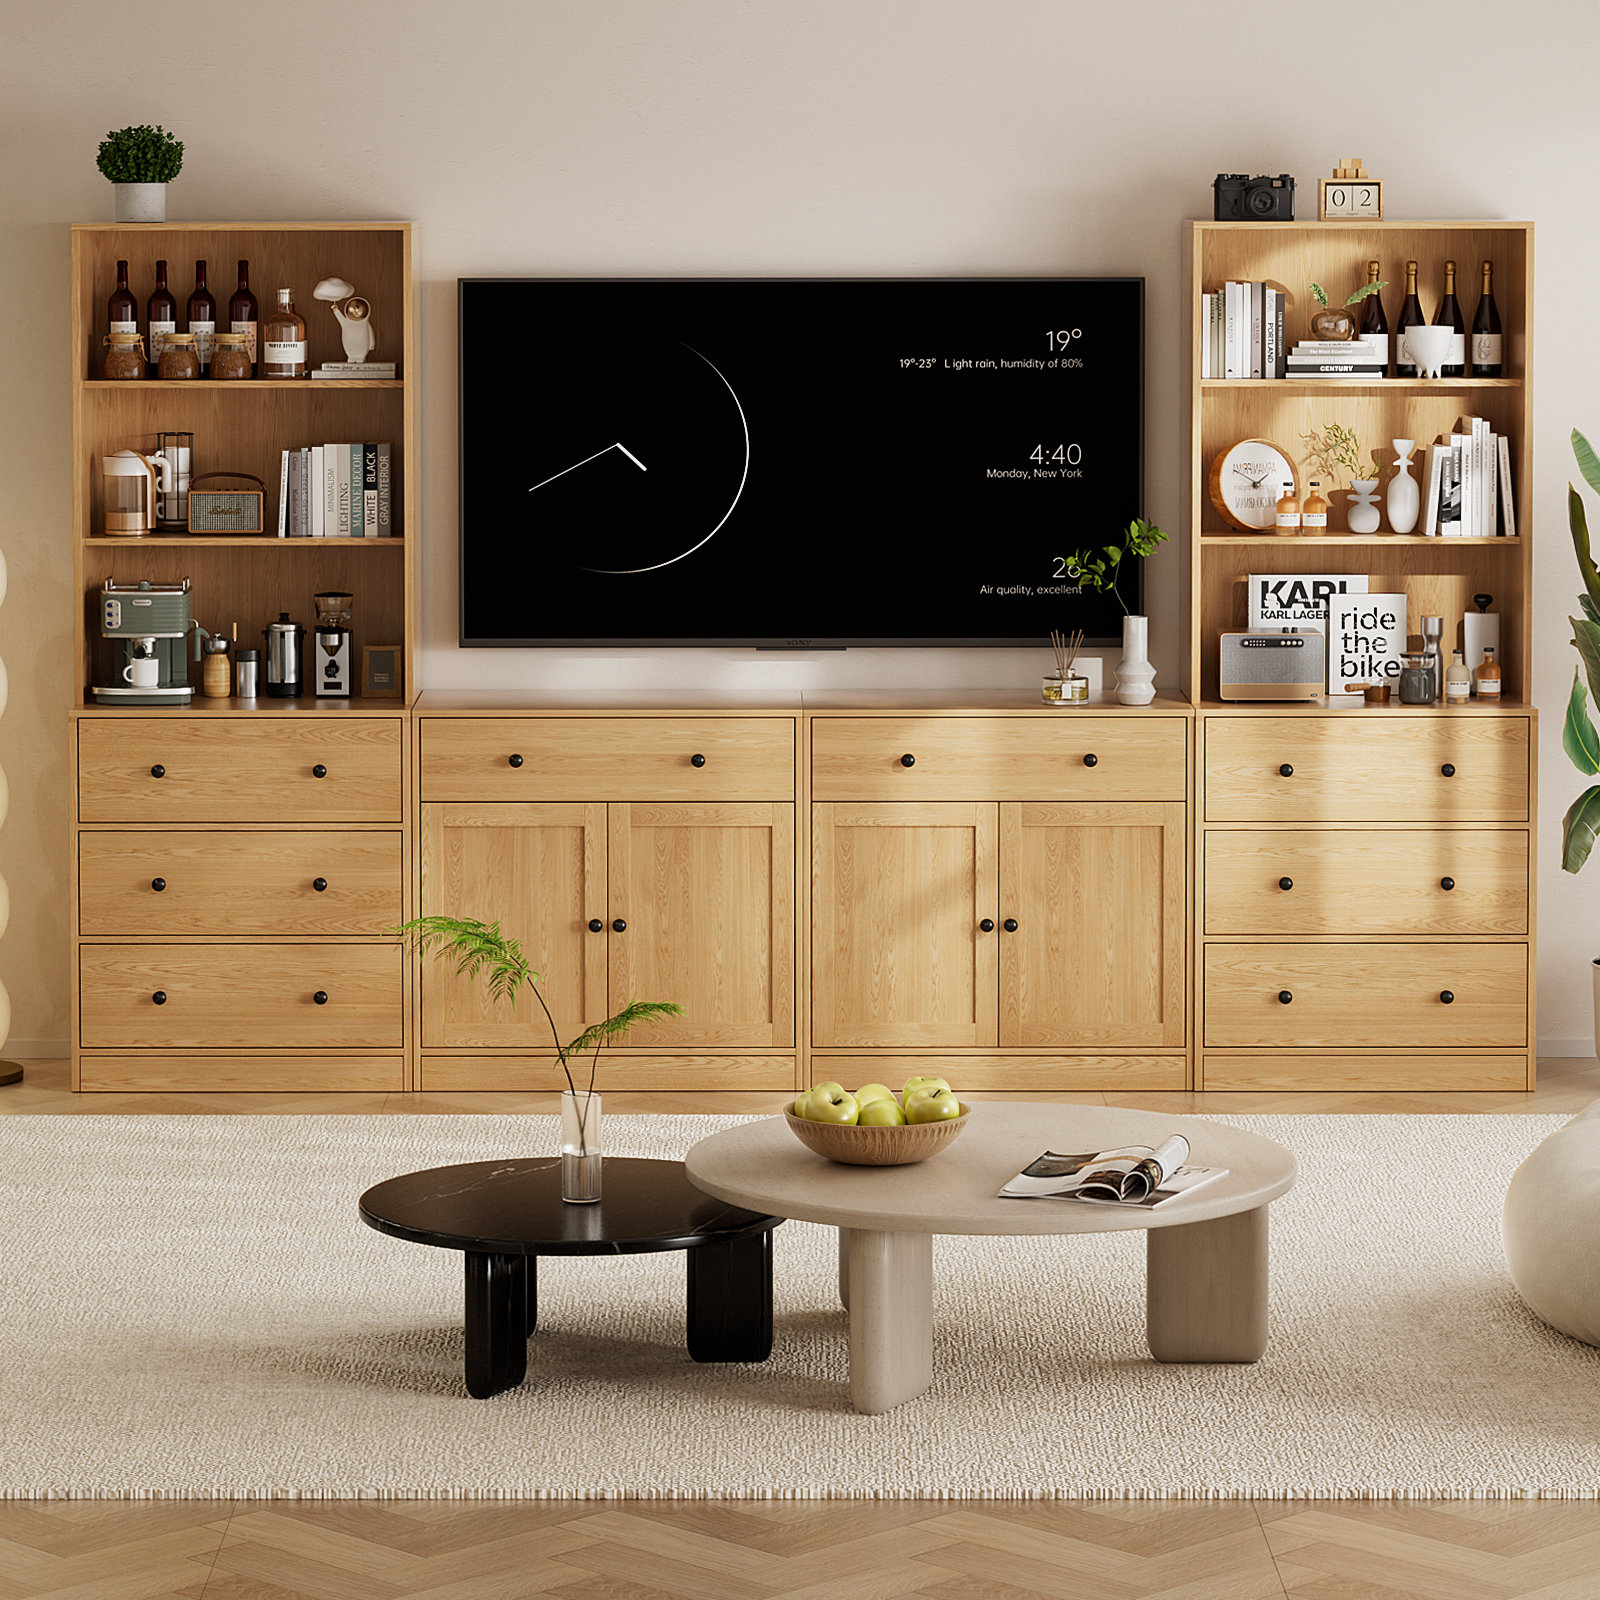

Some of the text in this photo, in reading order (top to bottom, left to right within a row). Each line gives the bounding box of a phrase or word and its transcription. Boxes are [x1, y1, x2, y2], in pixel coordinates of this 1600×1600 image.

[1360, 189, 1371, 207] 2
[975, 358, 998, 370] rain,
[1000, 358, 1045, 371] humidity
[1047, 358, 1059, 369] of
[1061, 358, 1084, 369] 80%
[1029, 443, 1082, 465] 4:40
[986, 468, 1083, 480] Monday, New York
[327, 468, 335, 513] MINIMALISM
[352, 454, 362, 527] MARINE DECOR
[366, 452, 376, 525] WHITE BLACK
[379, 456, 389, 525] GRAY INTERIOR
[340, 483, 349, 532] LIGHTING
[979, 585, 1083, 597] Air quality, excellent
[1261, 610, 1291, 620] KARL
[1341, 607, 1396, 630] ride
[1341, 631, 1388, 654] the
[1340, 655, 1400, 678] bike
